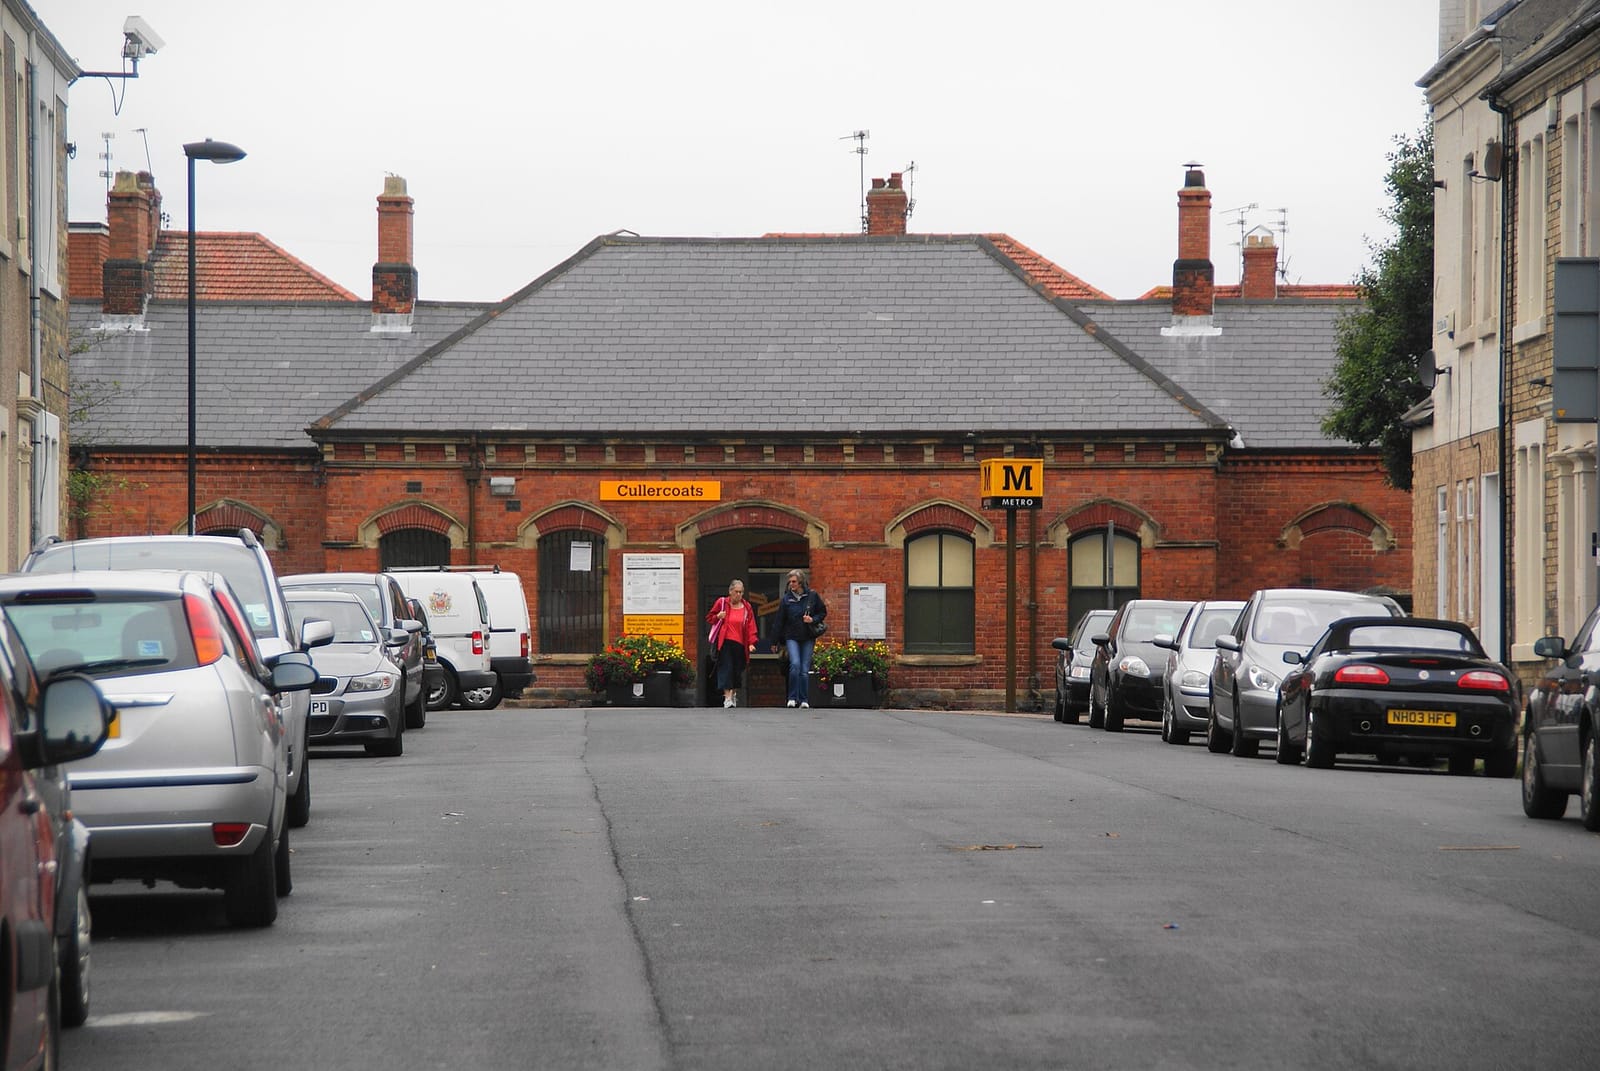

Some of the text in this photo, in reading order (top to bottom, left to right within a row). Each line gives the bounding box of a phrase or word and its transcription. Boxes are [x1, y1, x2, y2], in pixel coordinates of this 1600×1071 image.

[1002, 465, 1033, 491] M
[617, 484, 704, 497] Cullercoats
[1001, 498, 1034, 506] METRO
[1392, 711, 1452, 725] NH03 HFC
